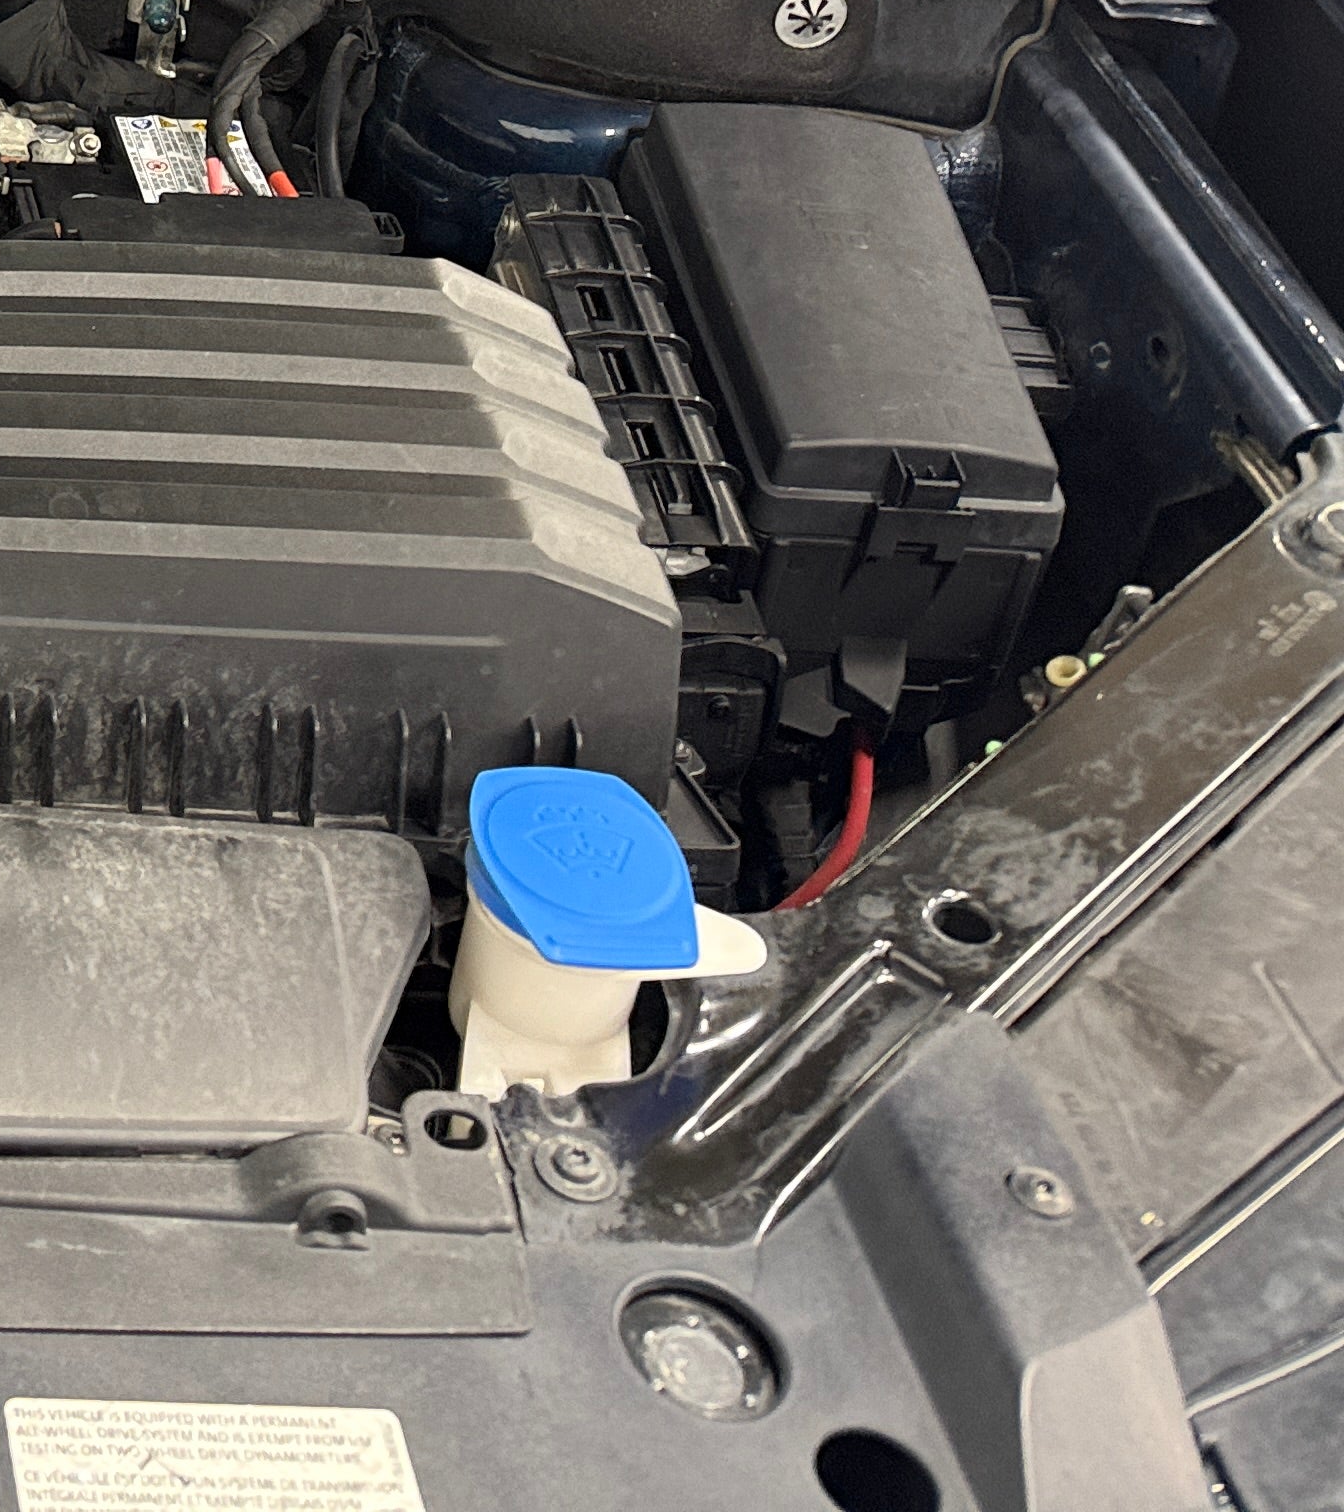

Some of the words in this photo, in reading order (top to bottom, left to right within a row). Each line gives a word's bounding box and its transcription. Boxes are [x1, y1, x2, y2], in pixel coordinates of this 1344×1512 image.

[13, 1407, 45, 1421] THIS
[47, 1409, 105, 1422] VEHICLE
[109, 1410, 121, 1423] IS
[124, 1410, 194, 1426] EQUIPPED
[197, 1414, 236, 1426] WITH
[96, 1426, 143, 1441] DRIVE
[197, 1430, 229, 1443] AND
[20, 1441, 78, 1456] TESTING
[80, 1443, 103, 1456] ON
[105, 1444, 142, 1458] TWO
[23, 1469, 40, 1484] CE
